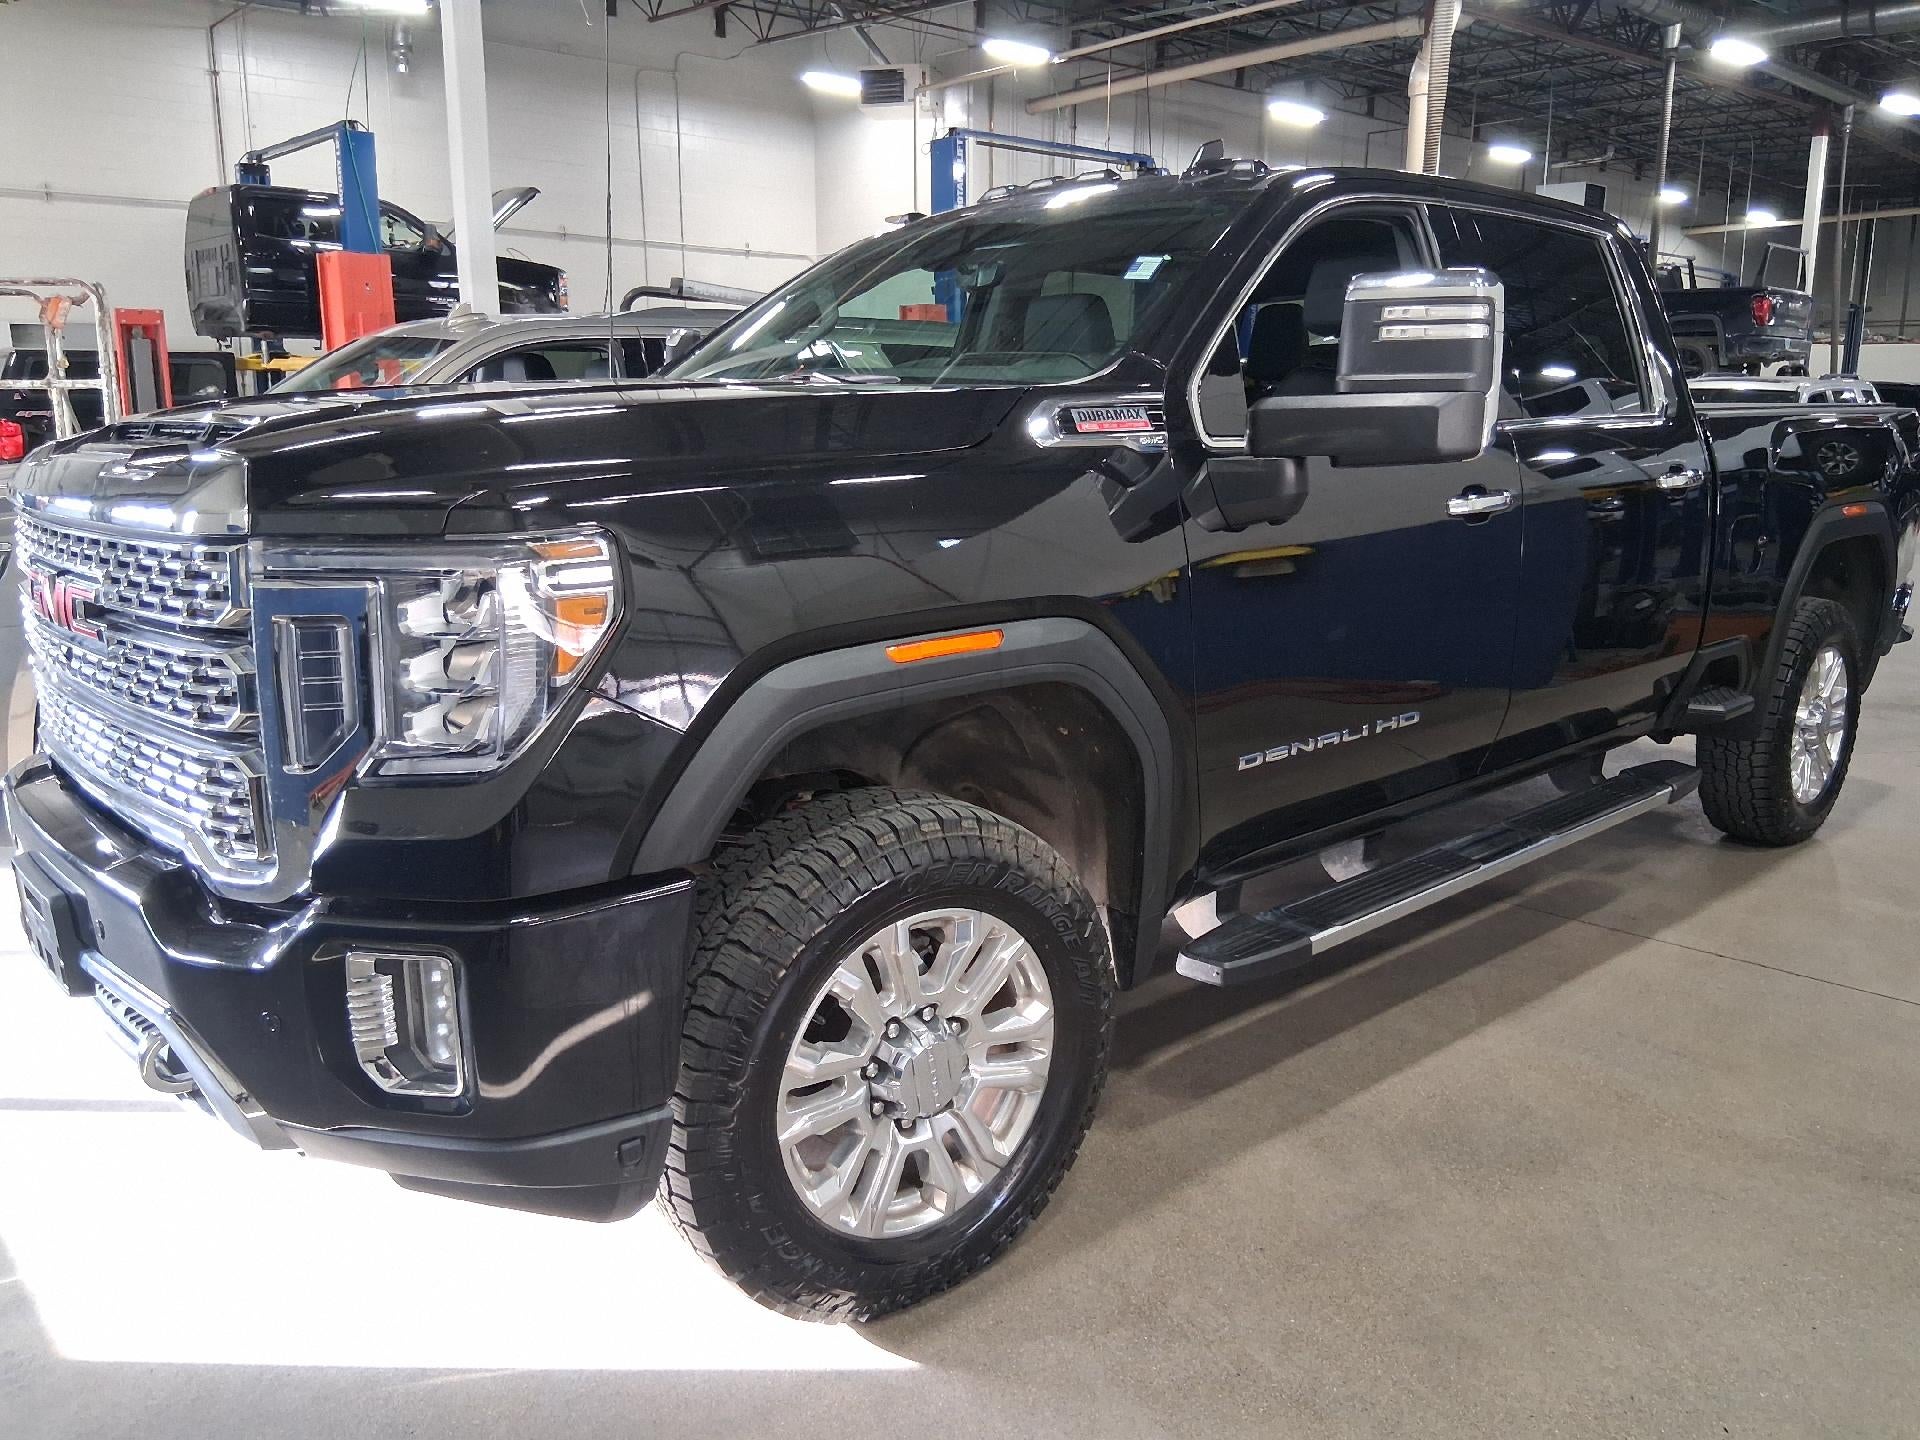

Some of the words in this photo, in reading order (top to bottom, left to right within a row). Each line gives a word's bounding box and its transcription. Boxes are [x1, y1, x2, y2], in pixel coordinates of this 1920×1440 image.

[956, 138, 964, 162] LIFT
[1077, 408, 1143, 422] DURAMAX
[1238, 724, 1369, 771] DENALI
[1375, 711, 1421, 734] HD
[899, 863, 997, 893] OPEN
[993, 869, 1083, 952] RANGE
